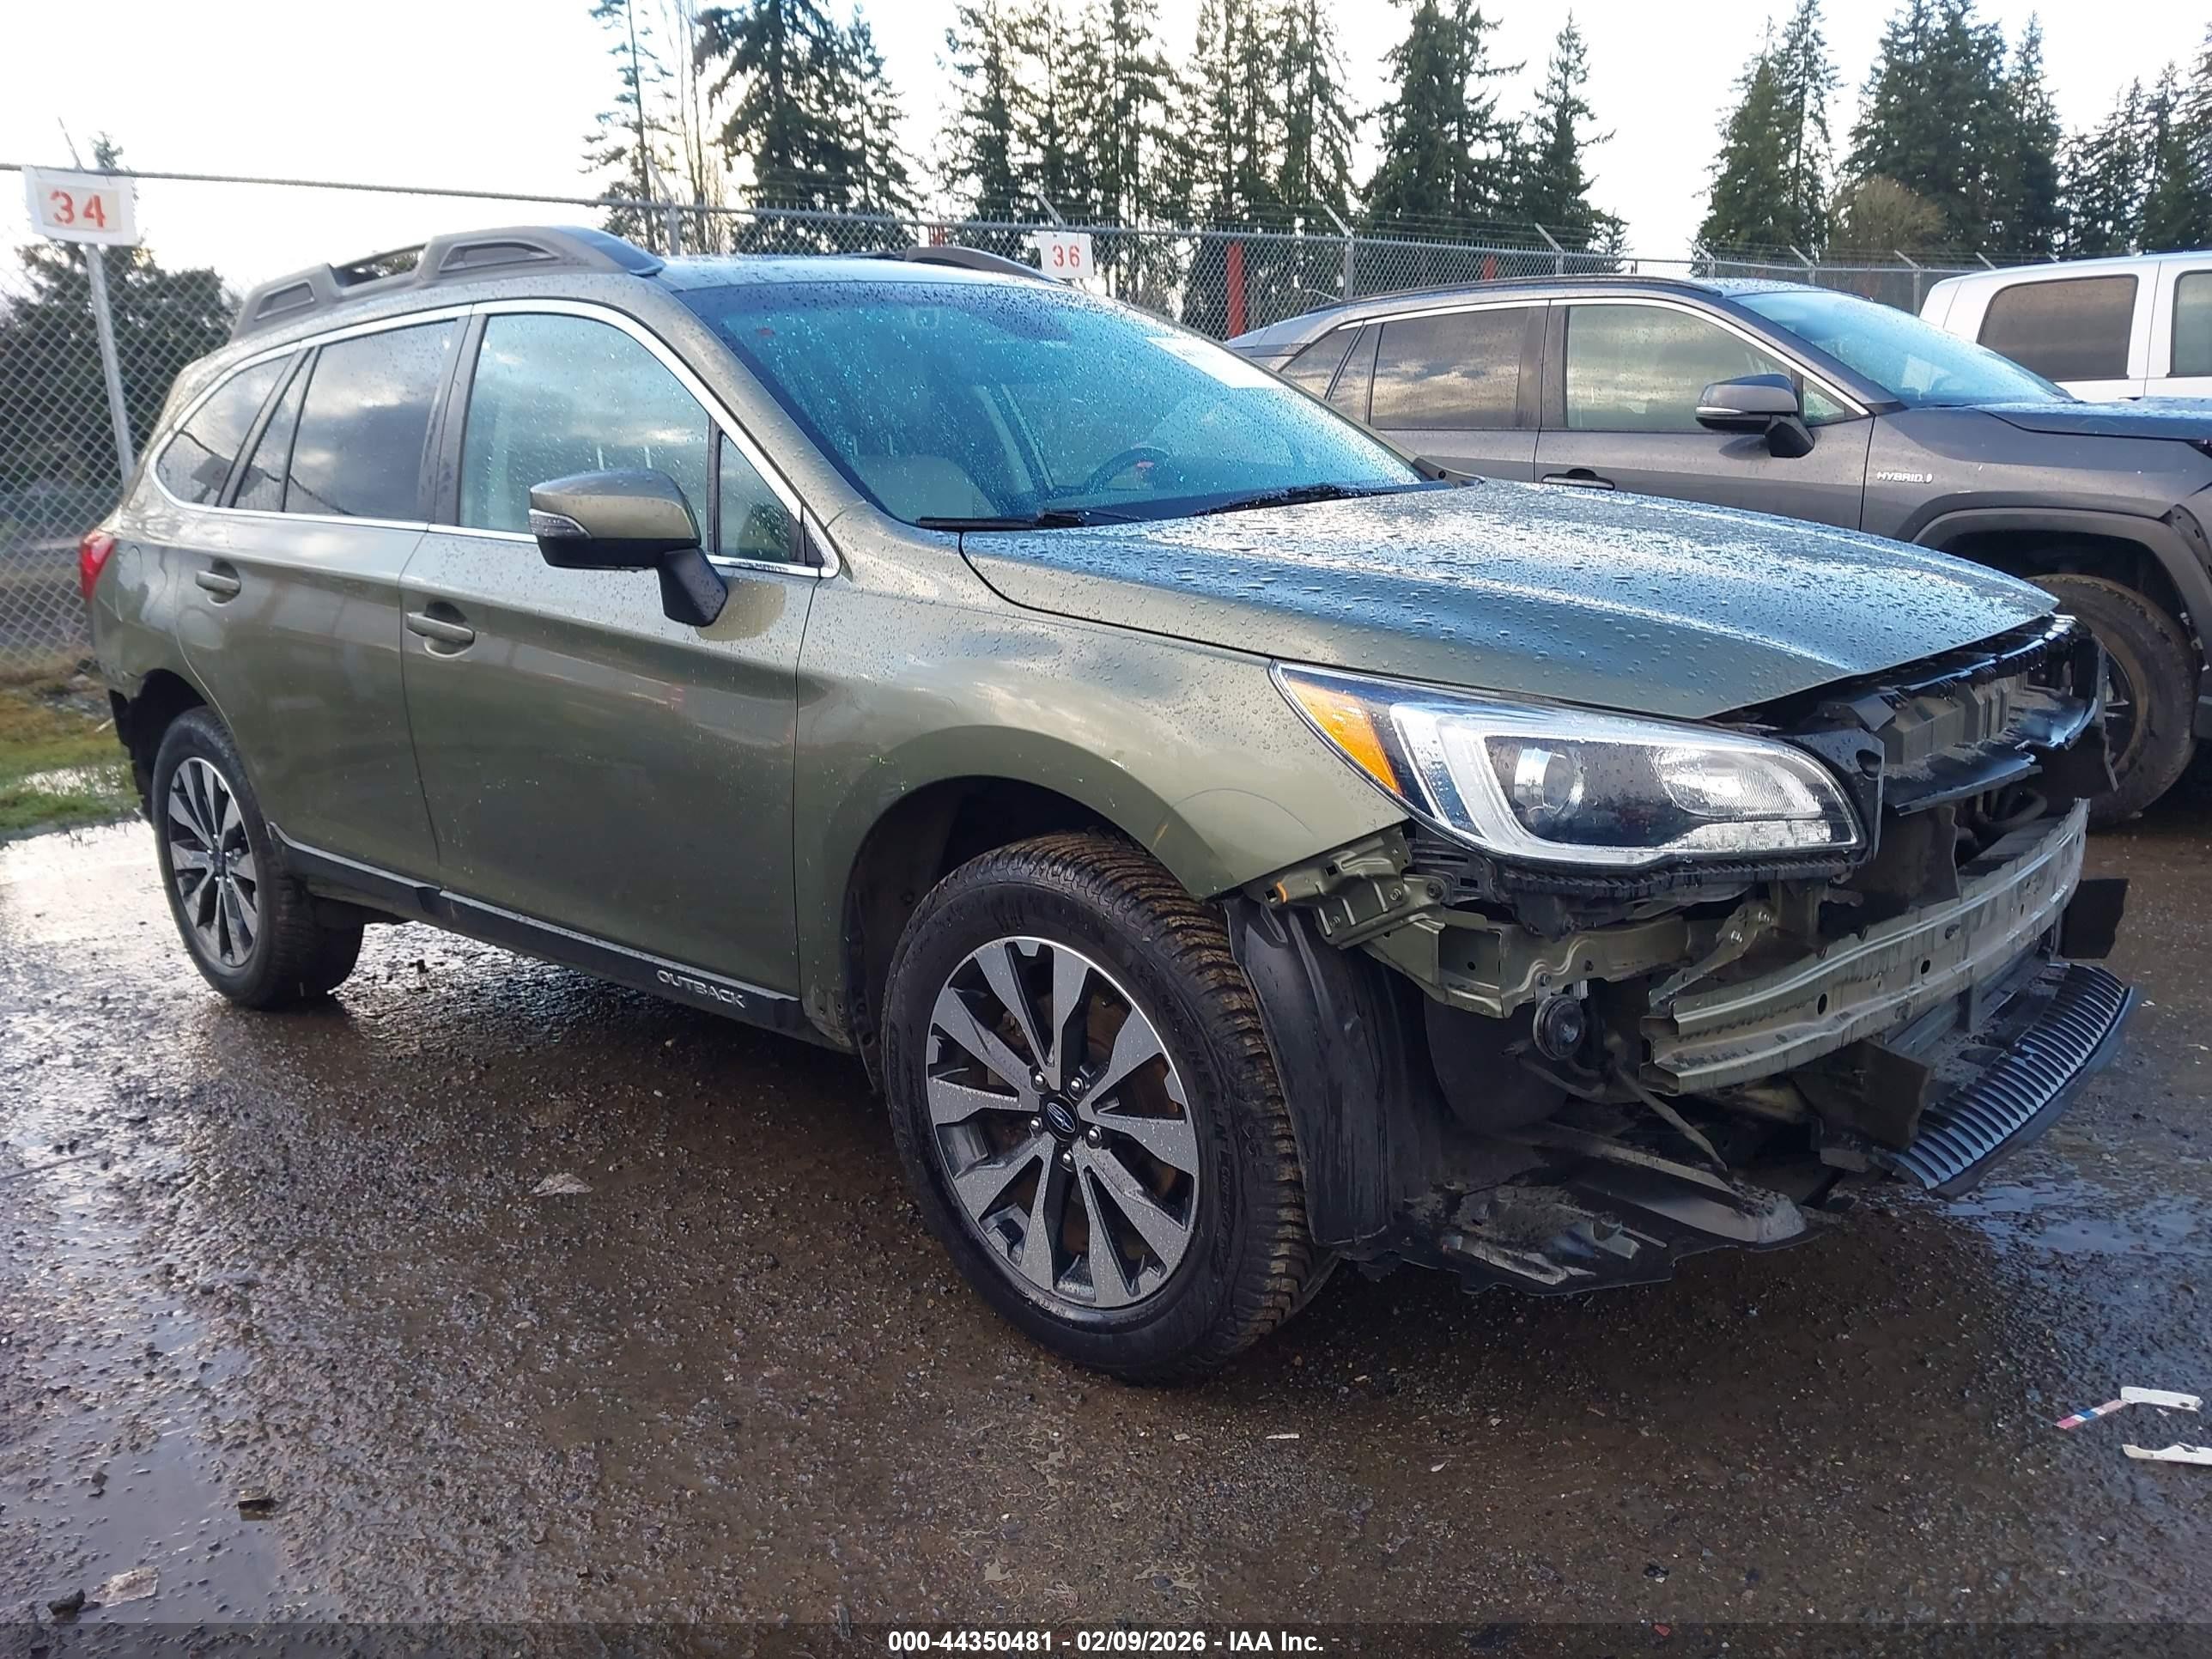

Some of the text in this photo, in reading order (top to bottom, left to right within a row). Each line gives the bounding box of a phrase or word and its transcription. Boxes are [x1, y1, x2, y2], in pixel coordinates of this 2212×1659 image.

[49, 189, 106, 228] 34
[1052, 244, 1080, 268] 36
[1876, 471, 1923, 483] HYBRID
[656, 969, 746, 1008] OUTBACK
